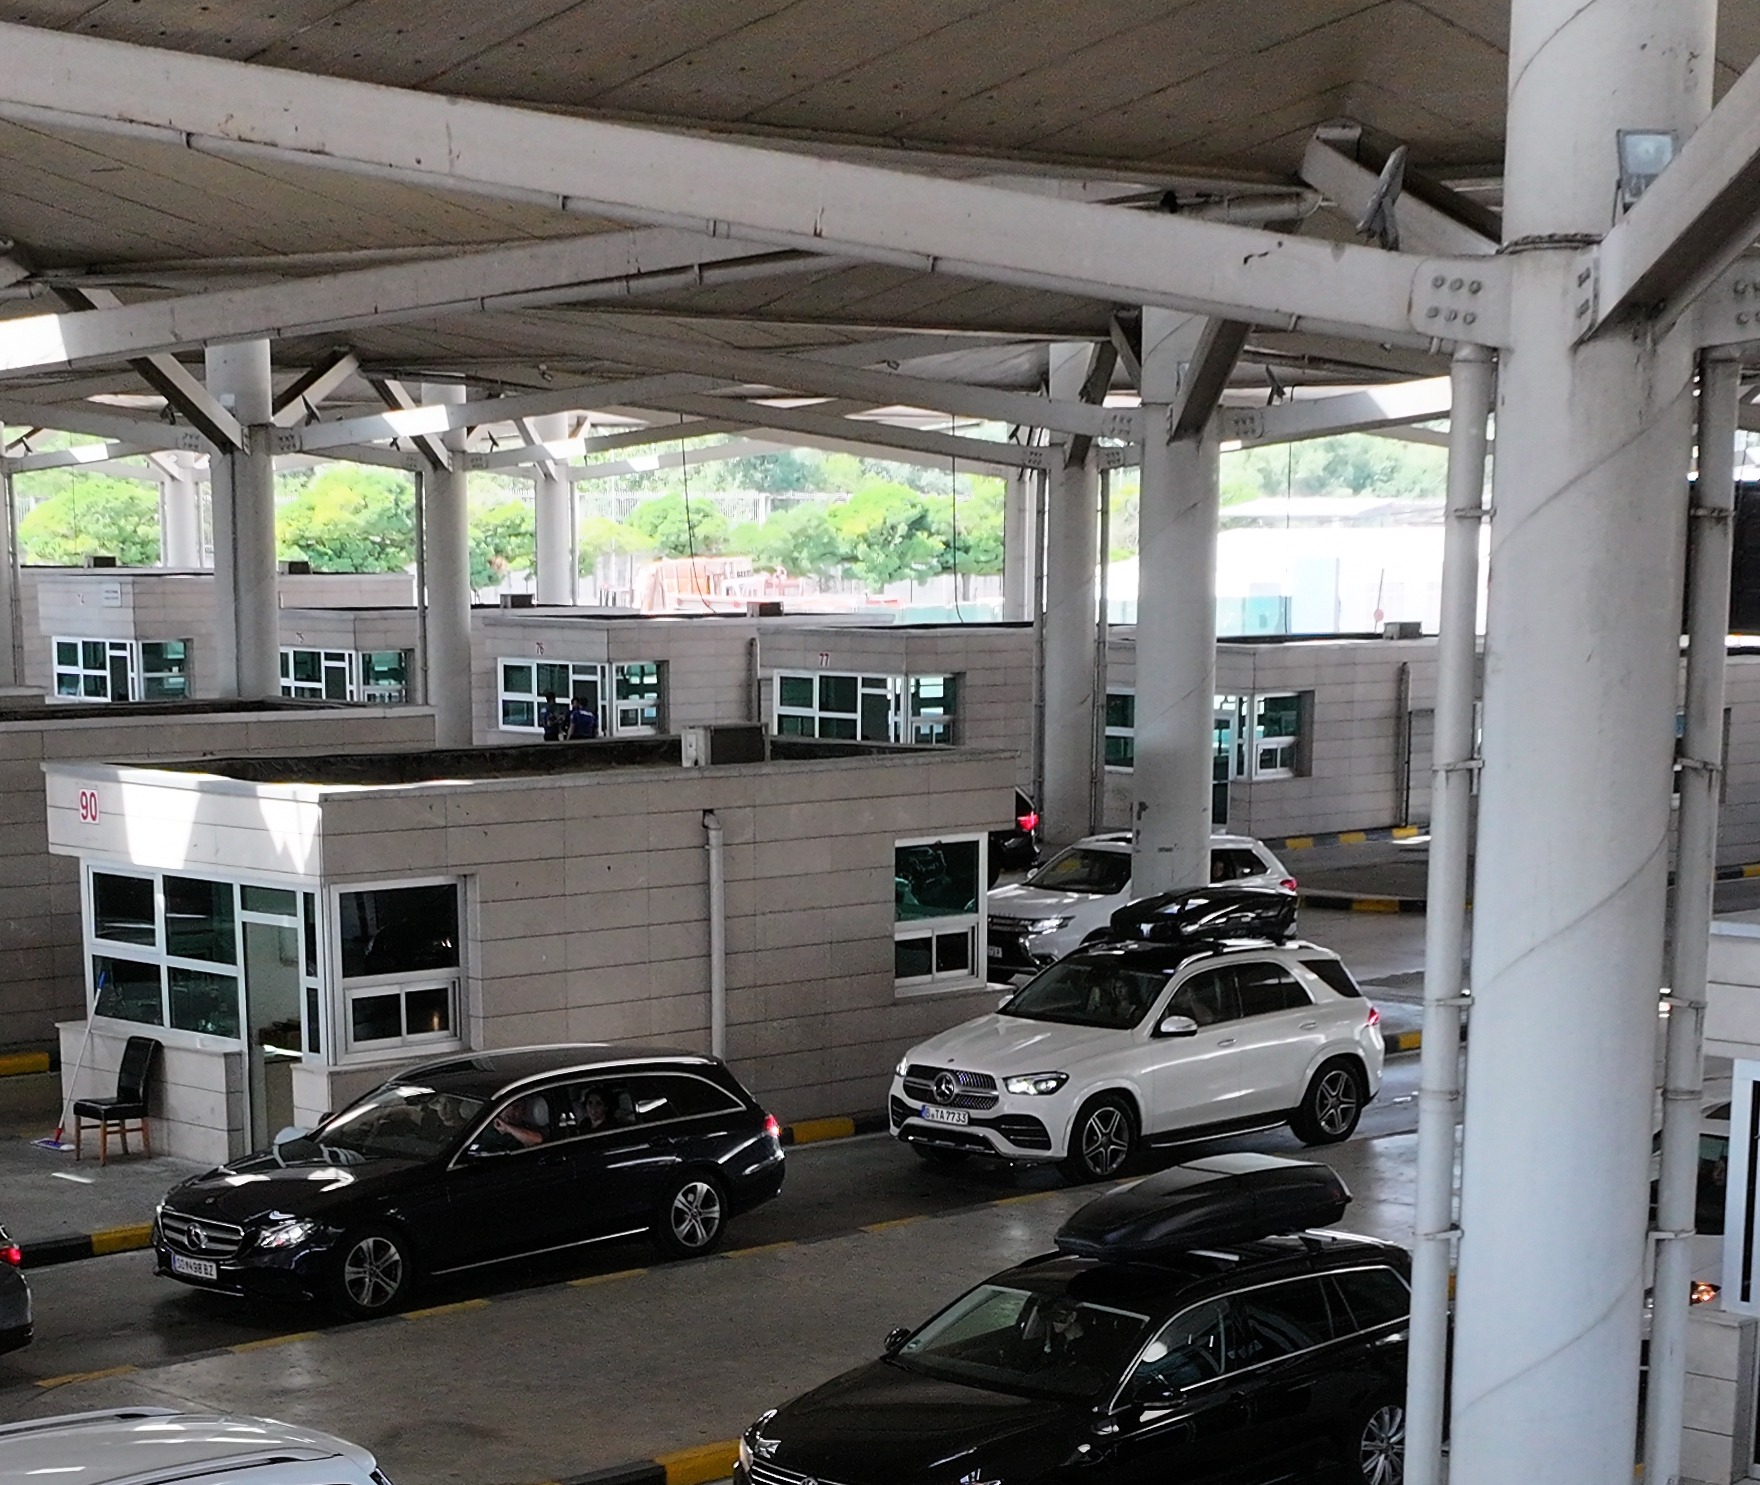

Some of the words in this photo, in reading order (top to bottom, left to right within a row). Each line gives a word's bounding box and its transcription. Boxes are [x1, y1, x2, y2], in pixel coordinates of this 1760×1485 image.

[819, 652, 830, 667] 77
[80, 791, 98, 821] 90
[946, 1110, 968, 1123] 7733
